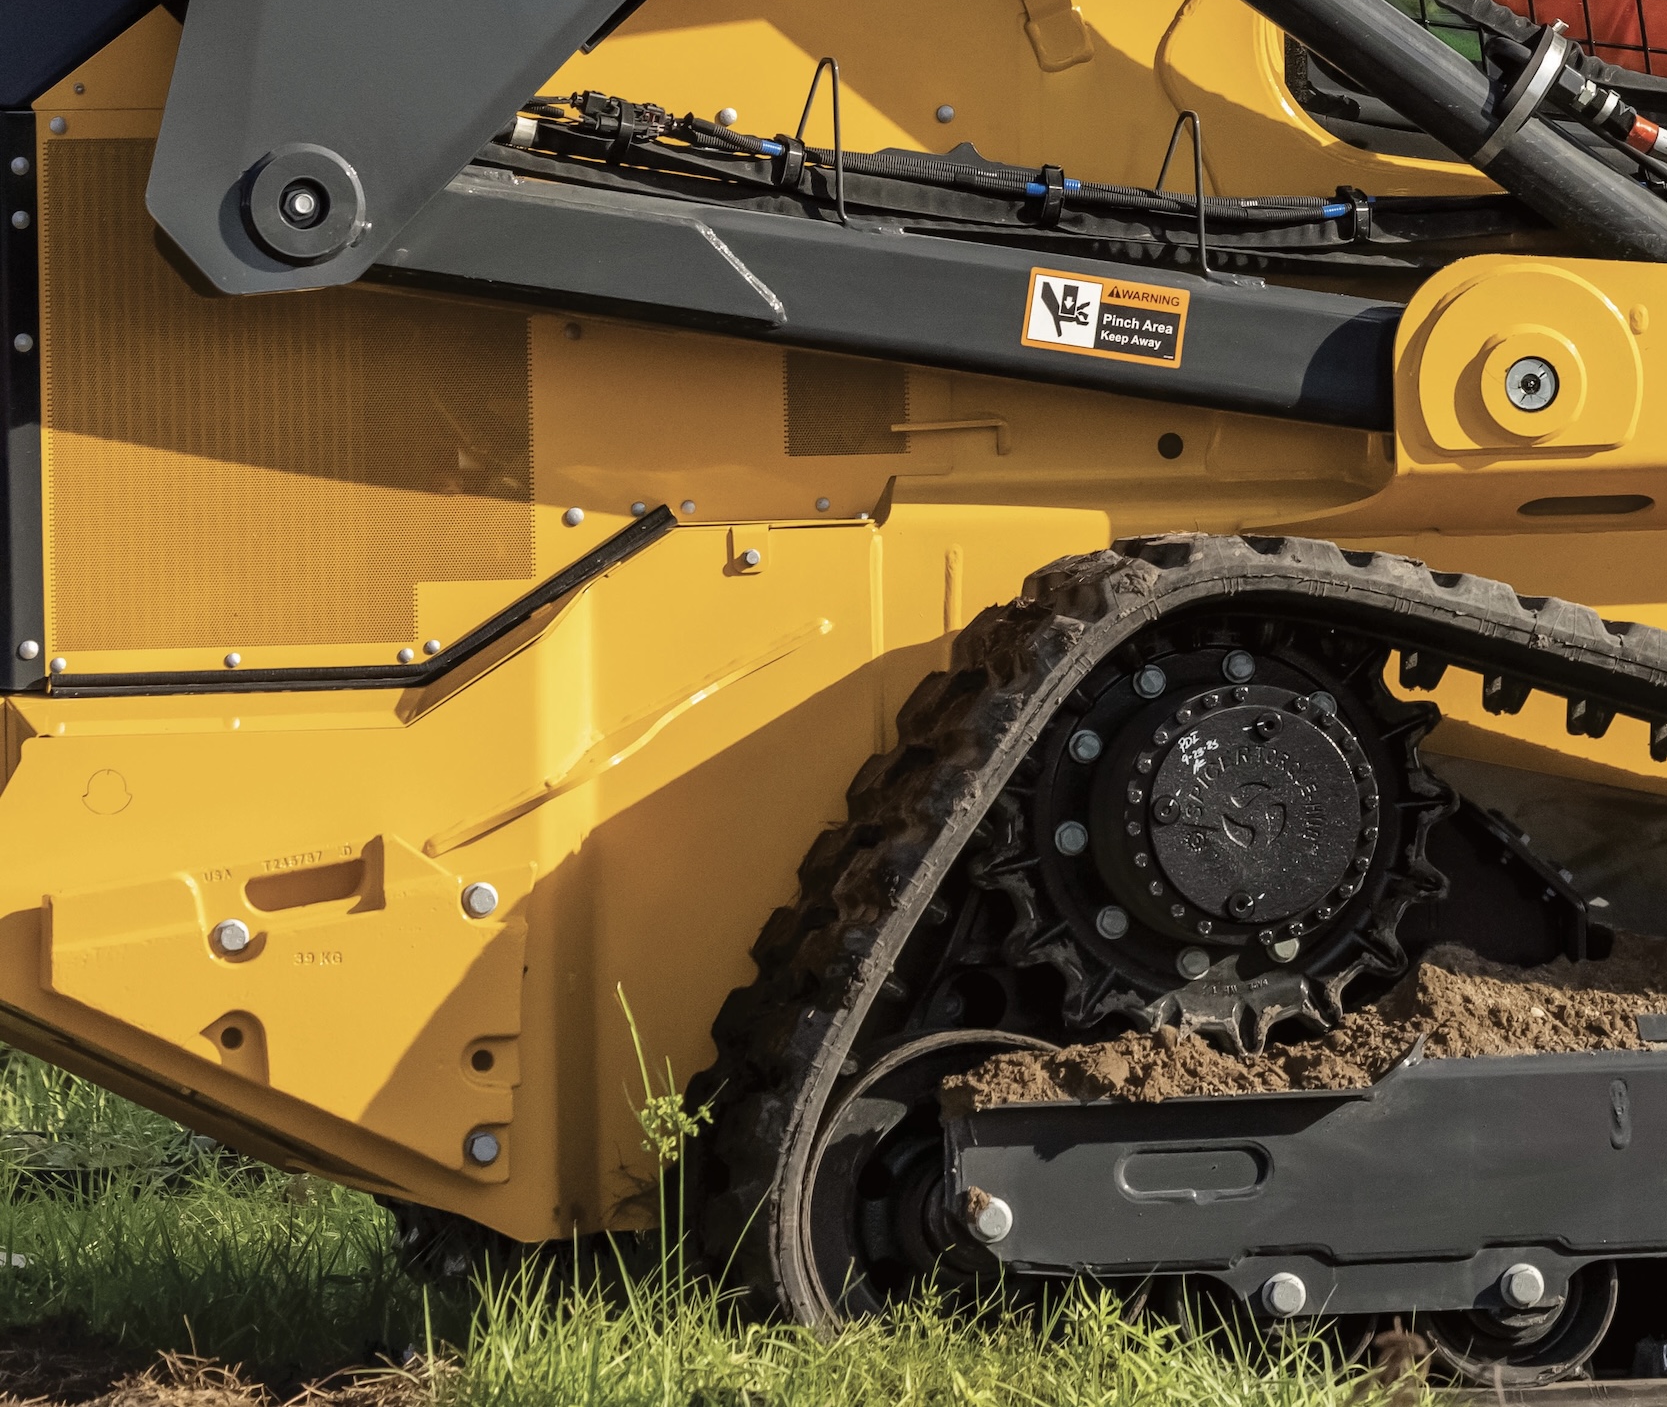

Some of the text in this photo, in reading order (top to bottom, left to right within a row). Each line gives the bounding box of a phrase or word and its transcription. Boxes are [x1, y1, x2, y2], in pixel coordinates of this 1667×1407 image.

[1122, 289, 1180, 307] WARNING
[1102, 313, 1173, 335] Pinch Area
[1100, 330, 1161, 350] Keep Away
[203, 868, 233, 882] USA
[320, 951, 343, 966] KG
